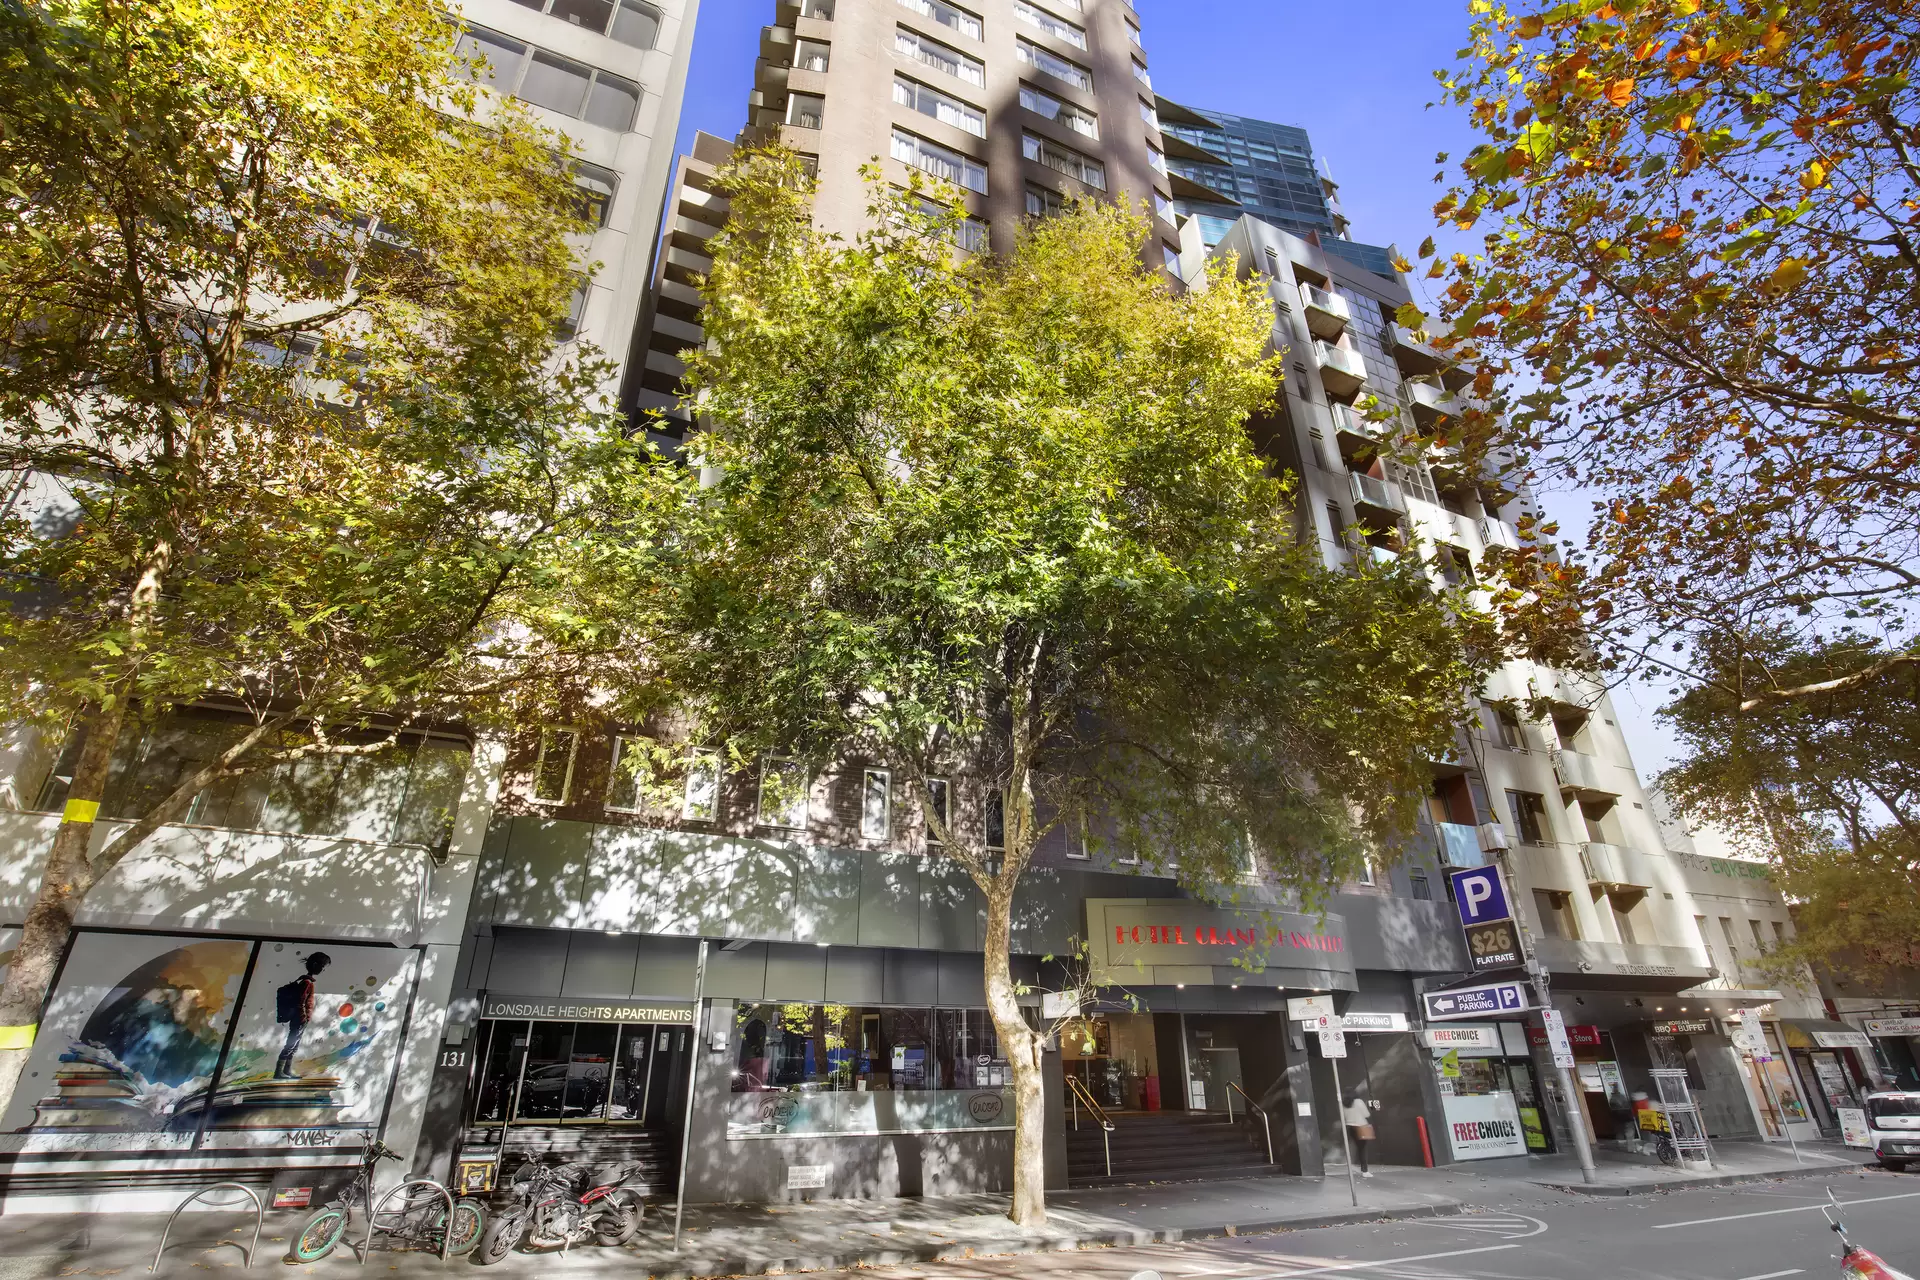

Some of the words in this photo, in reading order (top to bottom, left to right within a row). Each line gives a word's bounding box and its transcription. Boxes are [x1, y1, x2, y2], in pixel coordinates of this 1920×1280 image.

[1462, 875, 1492, 917] P
[1115, 925, 1189, 945] HOTEL
[1471, 928, 1511, 955] $26
[1476, 955, 1494, 965] FLAT
[1495, 952, 1515, 962] RATE
[1457, 992, 1486, 1003] PUBLIC
[1502, 989, 1516, 1006] P
[488, 1003, 556, 1017] LONSDALE
[558, 1005, 612, 1019] HEIGHTS
[613, 1007, 693, 1021] APARTMENTS
[1459, 1000, 1494, 1011] PARKING
[1353, 1016, 1390, 1026] PARKING
[1654, 1025, 1671, 1033] BBQ
[1678, 1023, 1707, 1032] BUFFET
[1433, 1030, 1479, 1041] FREECHOICE
[1574, 1034, 1592, 1043] Store
[440, 1051, 466, 1067] 131
[1452, 1119, 1517, 1142] FREECHOICE
